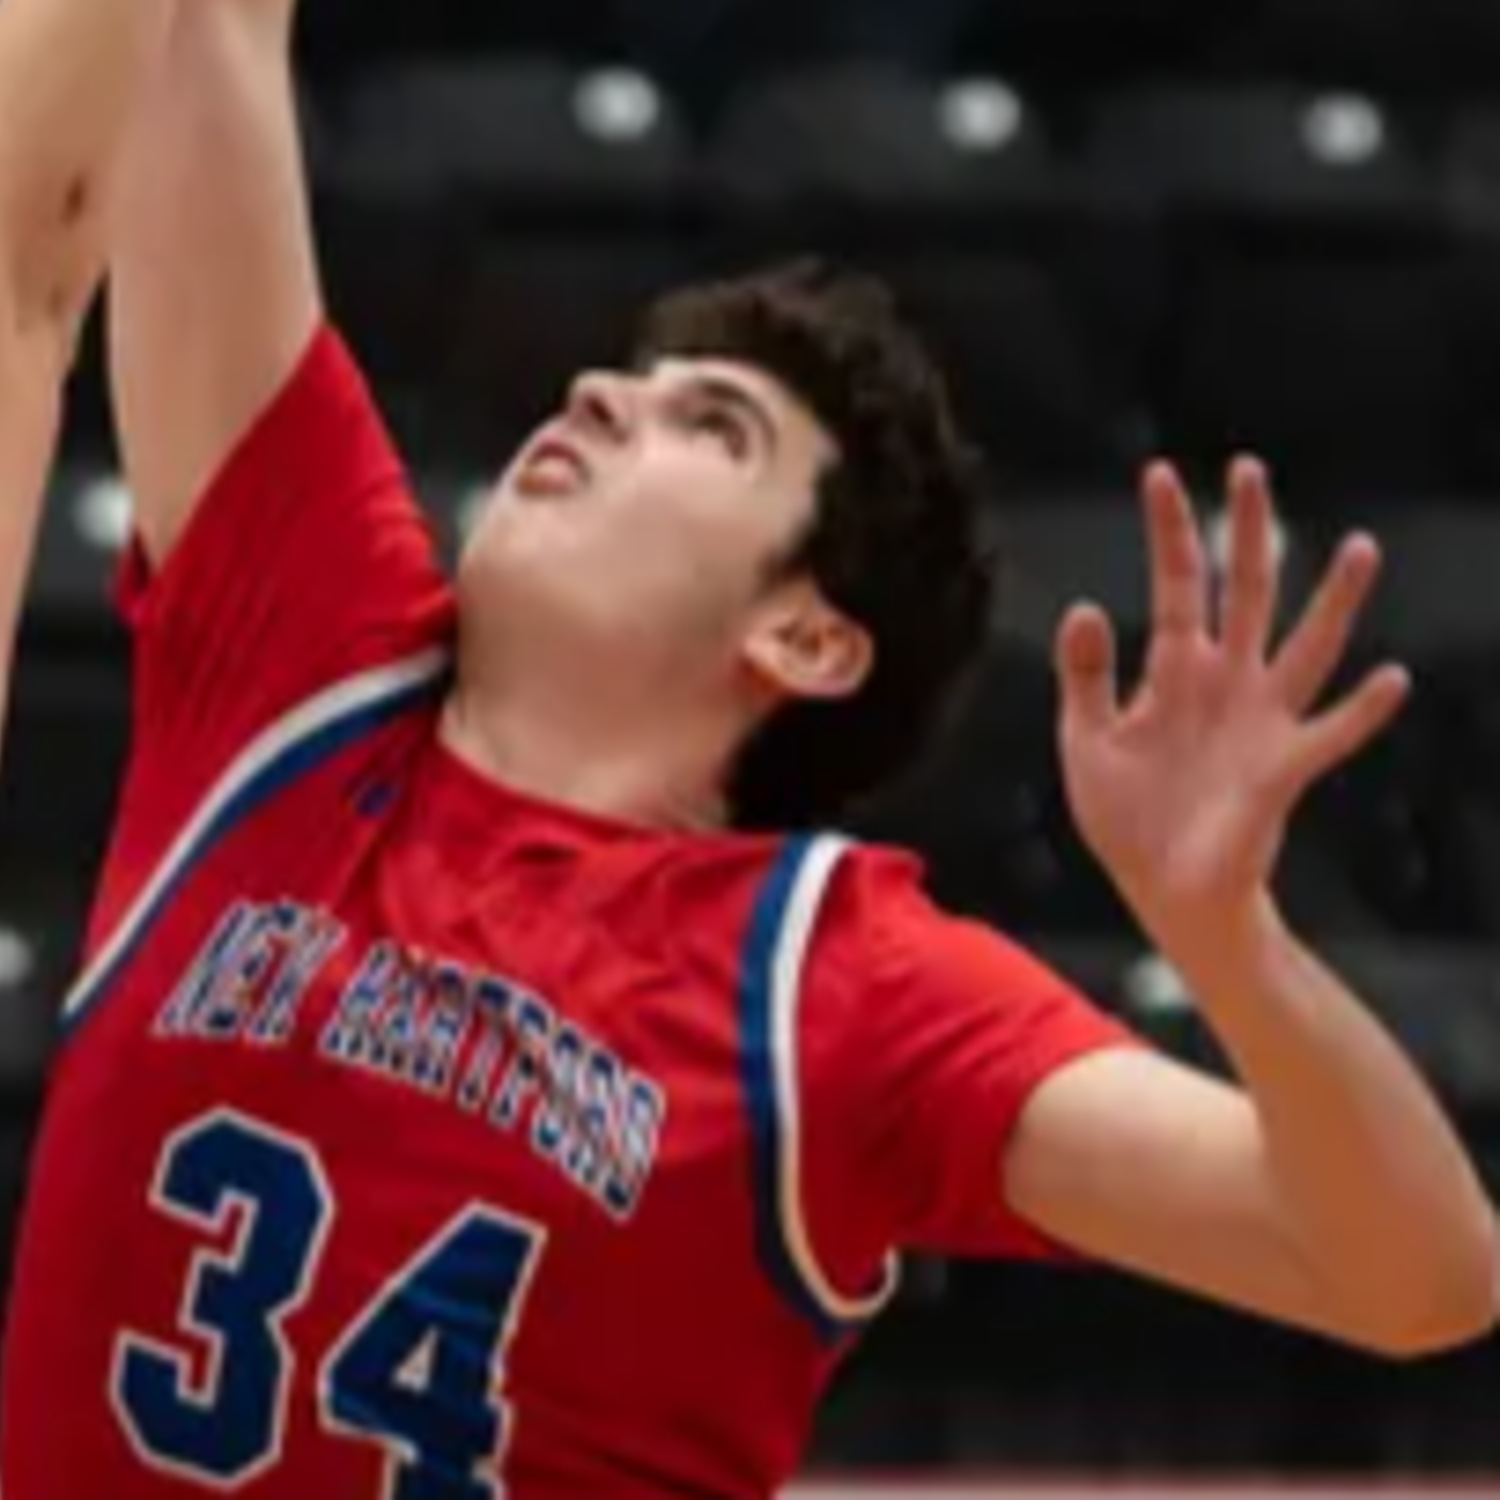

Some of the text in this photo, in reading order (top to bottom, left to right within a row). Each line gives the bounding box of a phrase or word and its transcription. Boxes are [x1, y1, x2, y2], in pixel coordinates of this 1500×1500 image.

[152, 897, 667, 1224] NEW HARTFORD
[111, 1106, 548, 1500] 34
